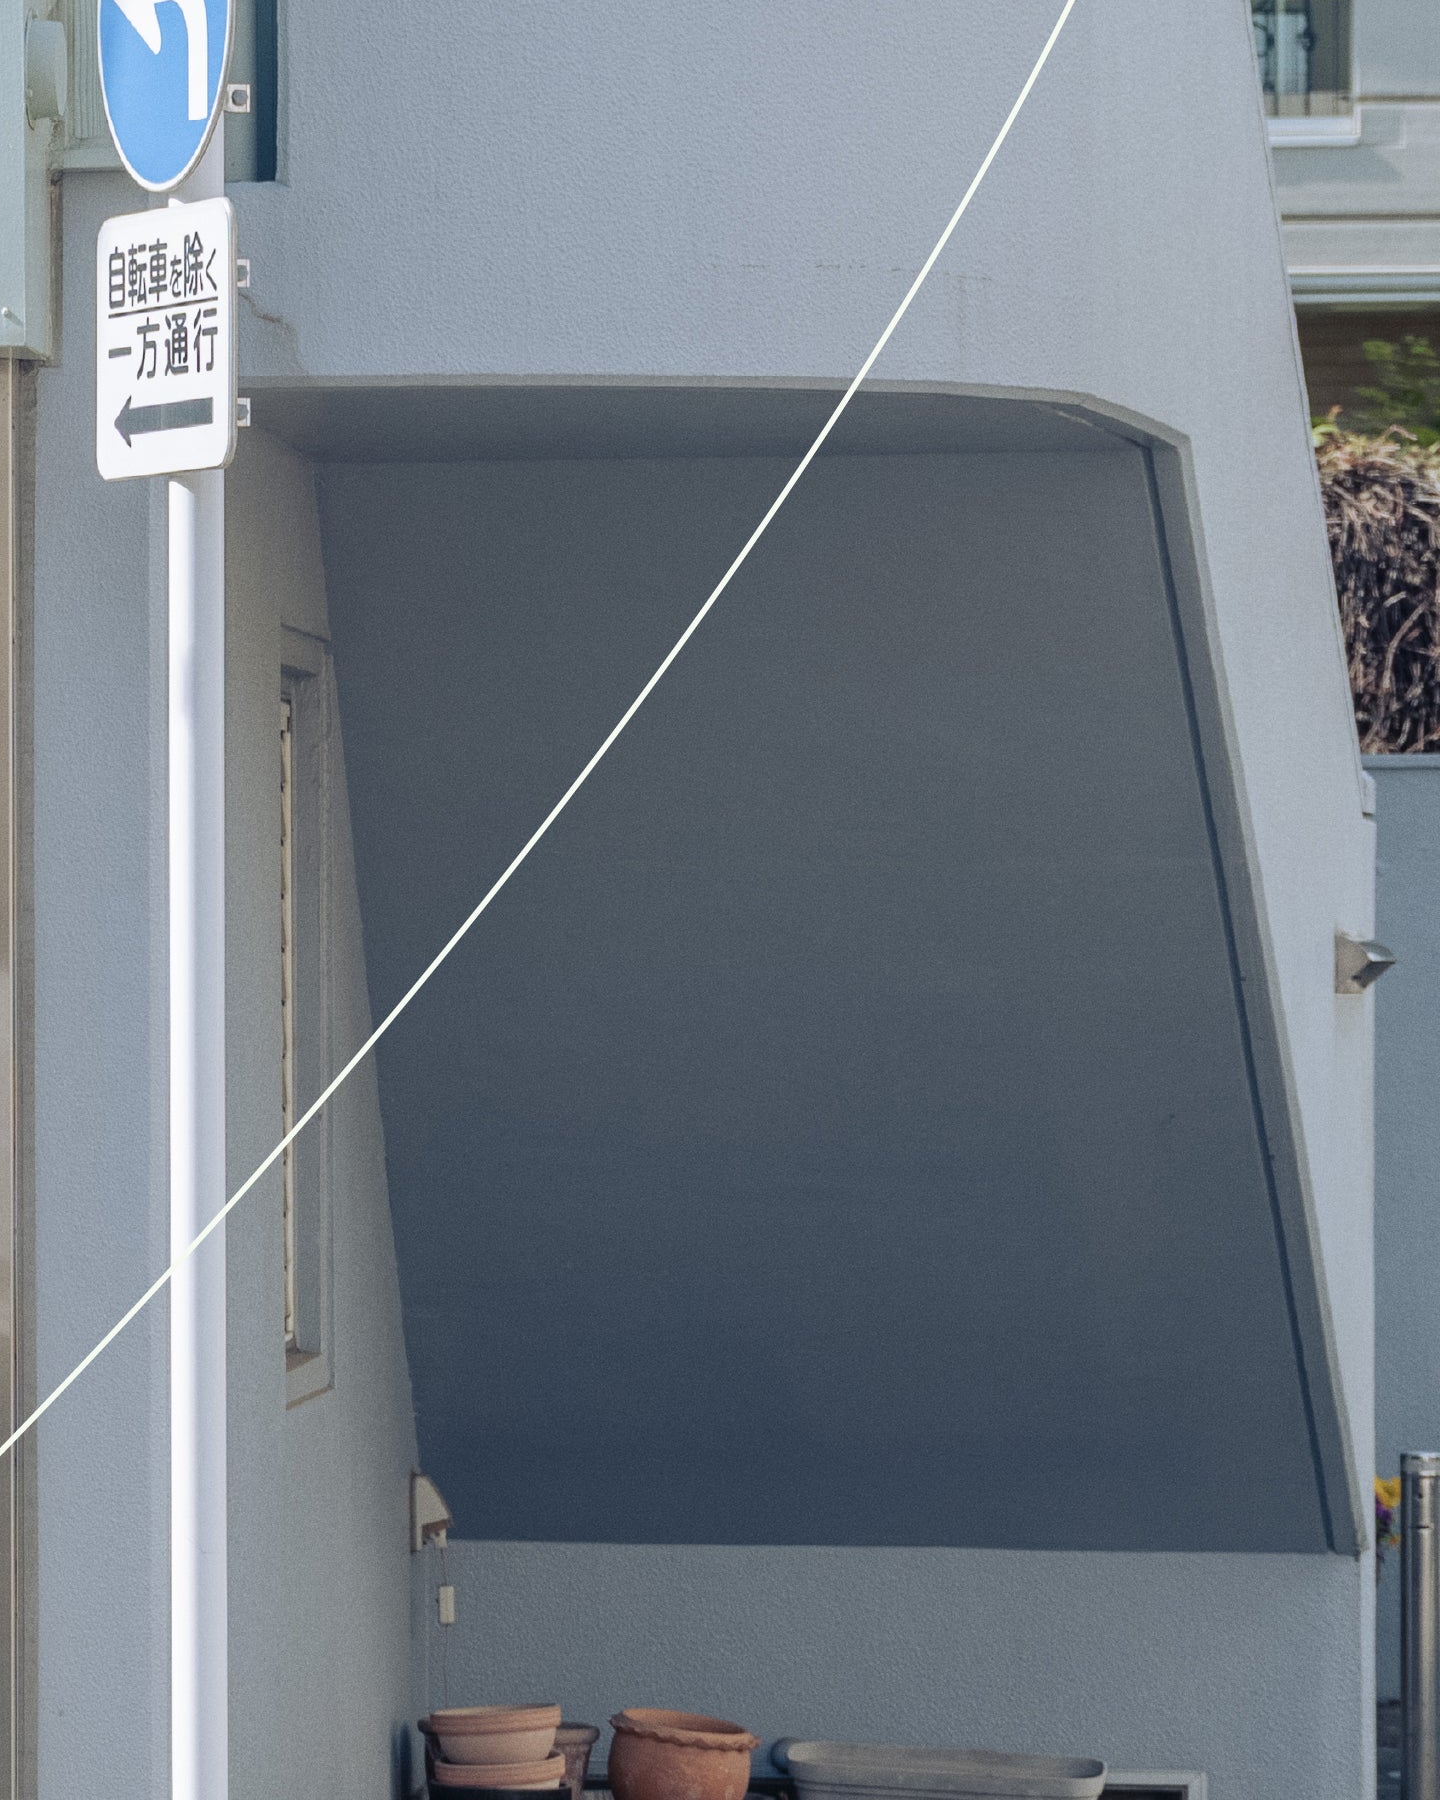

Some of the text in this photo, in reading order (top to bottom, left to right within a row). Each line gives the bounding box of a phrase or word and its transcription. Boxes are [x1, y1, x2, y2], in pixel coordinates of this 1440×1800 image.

[108, 231, 218, 310] 自転車を除く
[108, 307, 218, 381] 一方通行
